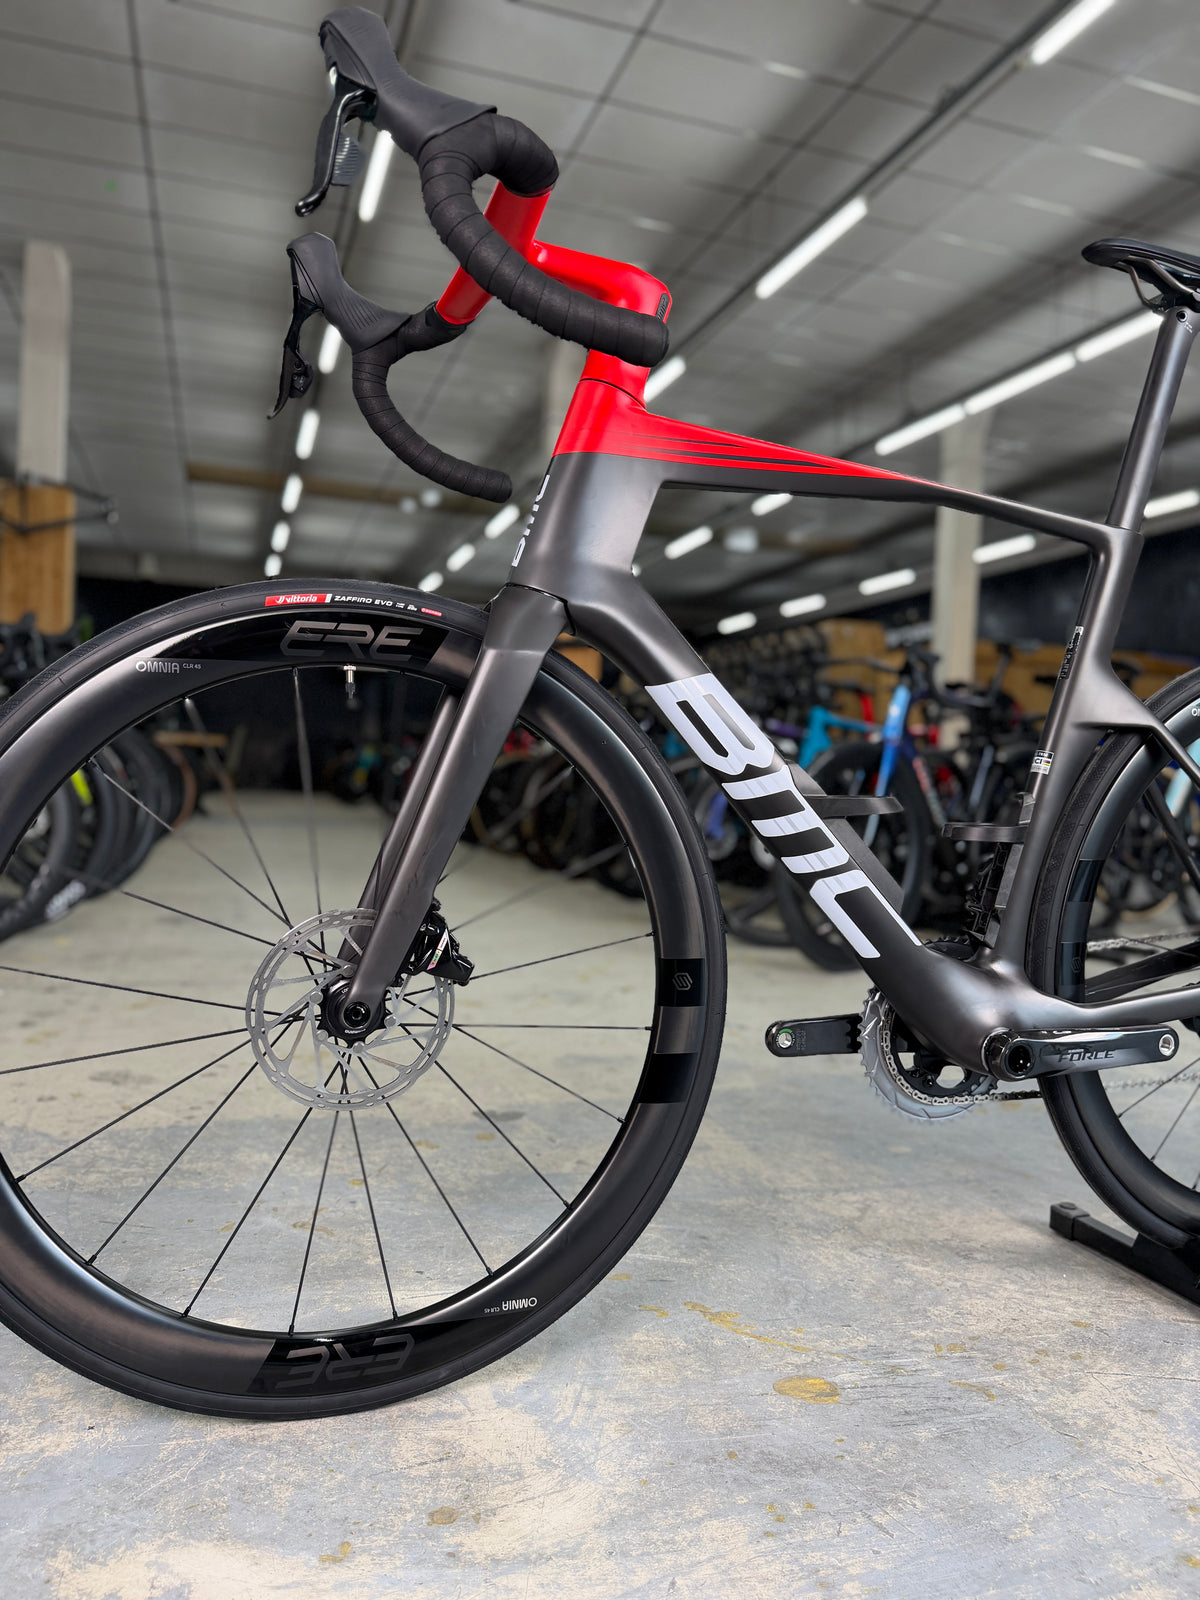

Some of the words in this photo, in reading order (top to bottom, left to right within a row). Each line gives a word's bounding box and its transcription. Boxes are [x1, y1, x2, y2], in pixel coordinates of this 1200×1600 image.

[285, 594, 318, 603] vittoria
[374, 599, 393, 607] EVO
[280, 620, 424, 661] ERE
[135, 660, 180, 673] OMNIA
[644, 673, 922, 958] BMC
[1058, 1049, 1115, 1063] FORCE
[502, 1297, 537, 1311] OMNIA
